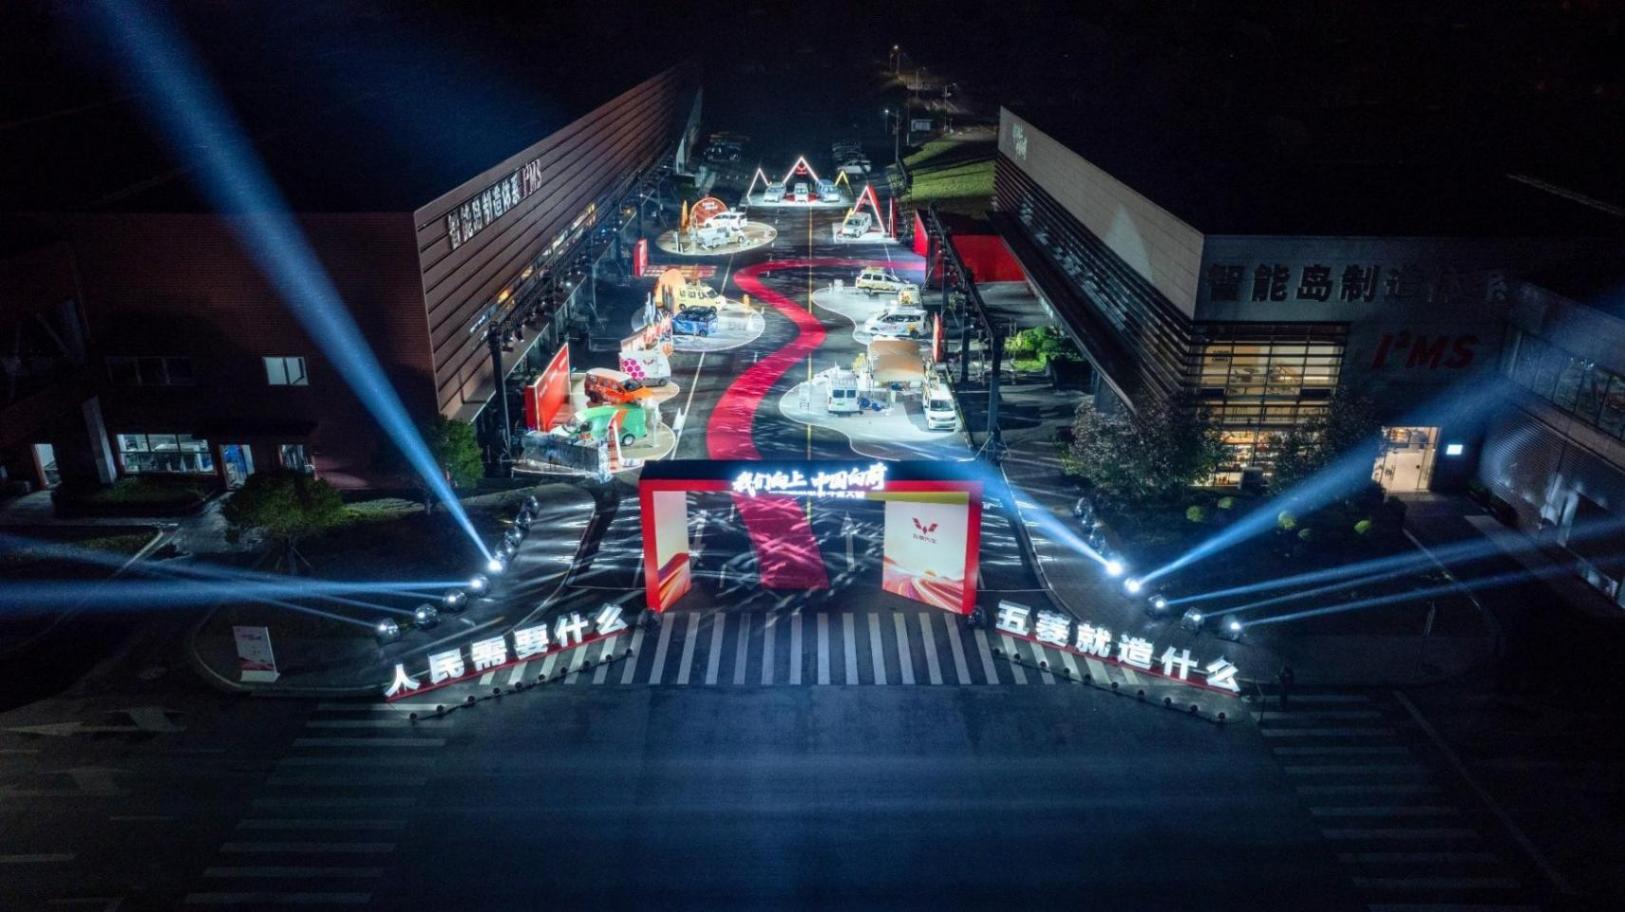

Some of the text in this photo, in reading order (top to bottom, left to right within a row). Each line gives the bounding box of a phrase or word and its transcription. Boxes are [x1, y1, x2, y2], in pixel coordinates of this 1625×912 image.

[1207, 263, 1509, 302] 智能岛制造
[384, 602, 629, 698] 人民需要什么
[995, 600, 1240, 693] 五菱就造什么
